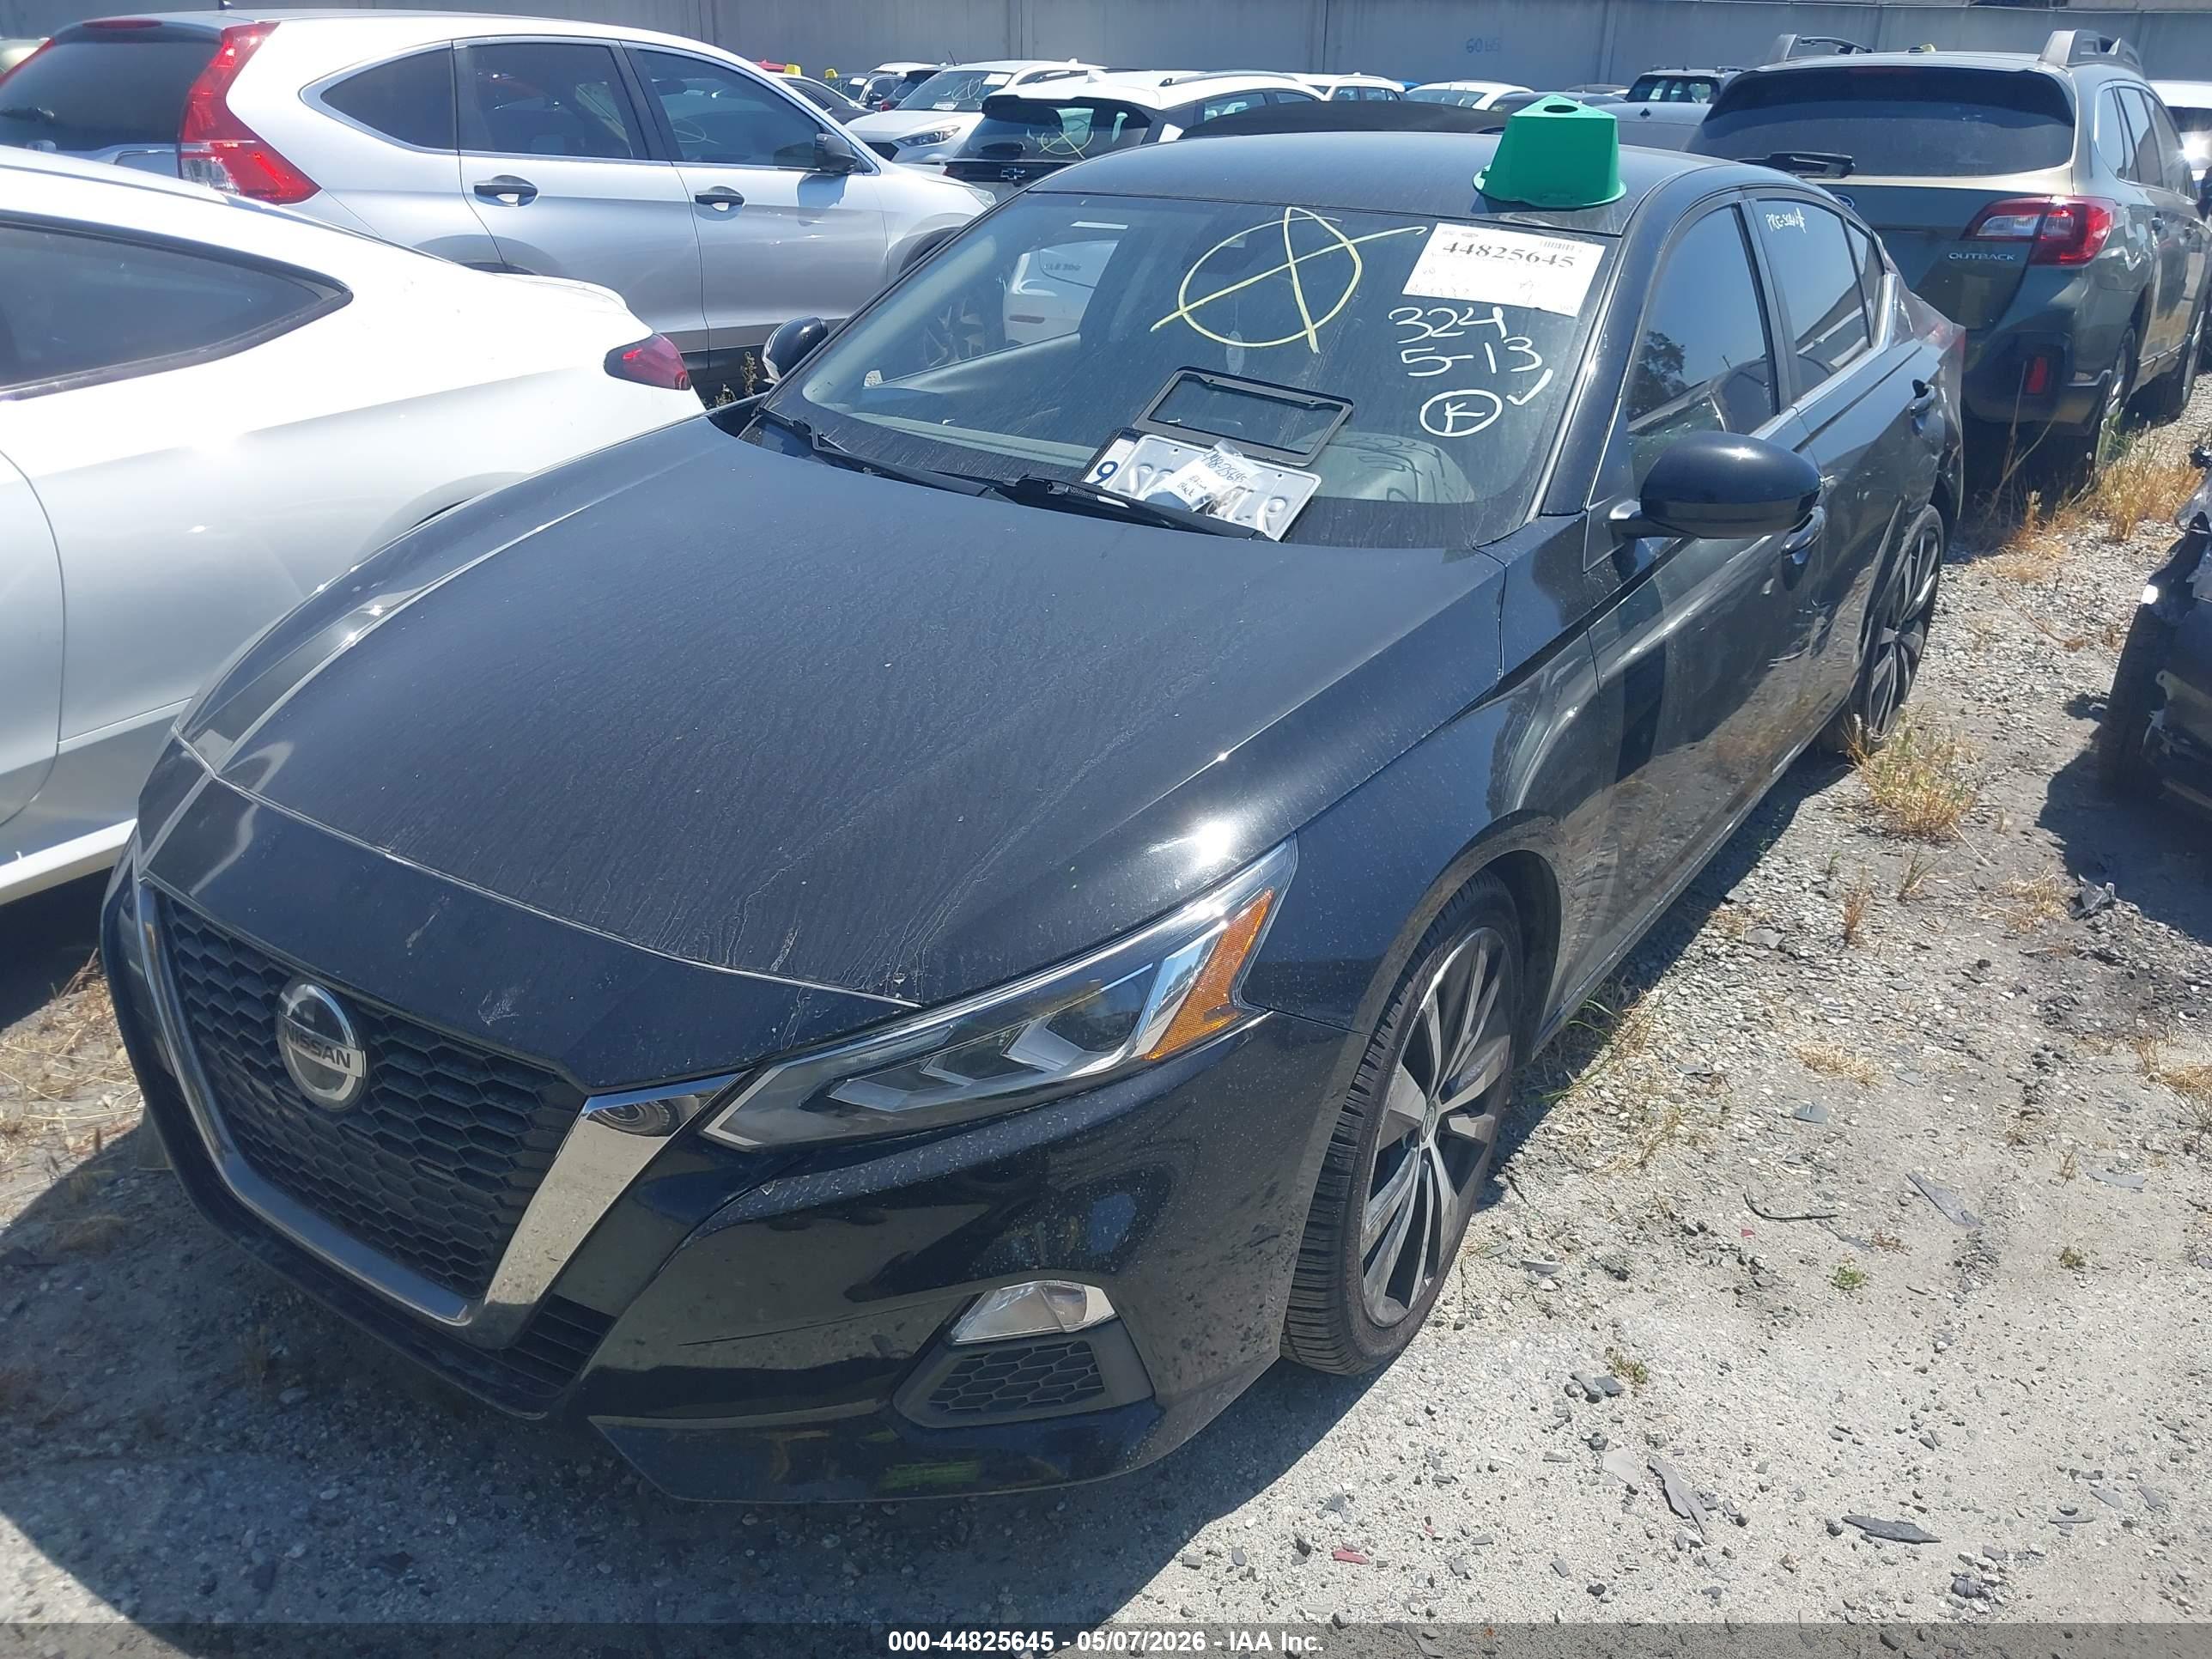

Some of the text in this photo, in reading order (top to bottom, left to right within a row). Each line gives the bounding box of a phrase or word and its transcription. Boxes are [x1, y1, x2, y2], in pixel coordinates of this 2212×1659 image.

[1442, 240, 1577, 268] 44825645
[1948, 252, 2015, 261] OUTBACK
[1388, 307, 1508, 344] 324
[1401, 336, 1543, 377] 5-13
[1443, 400, 1486, 434] K
[284, 1025, 351, 1068] NISSAN
